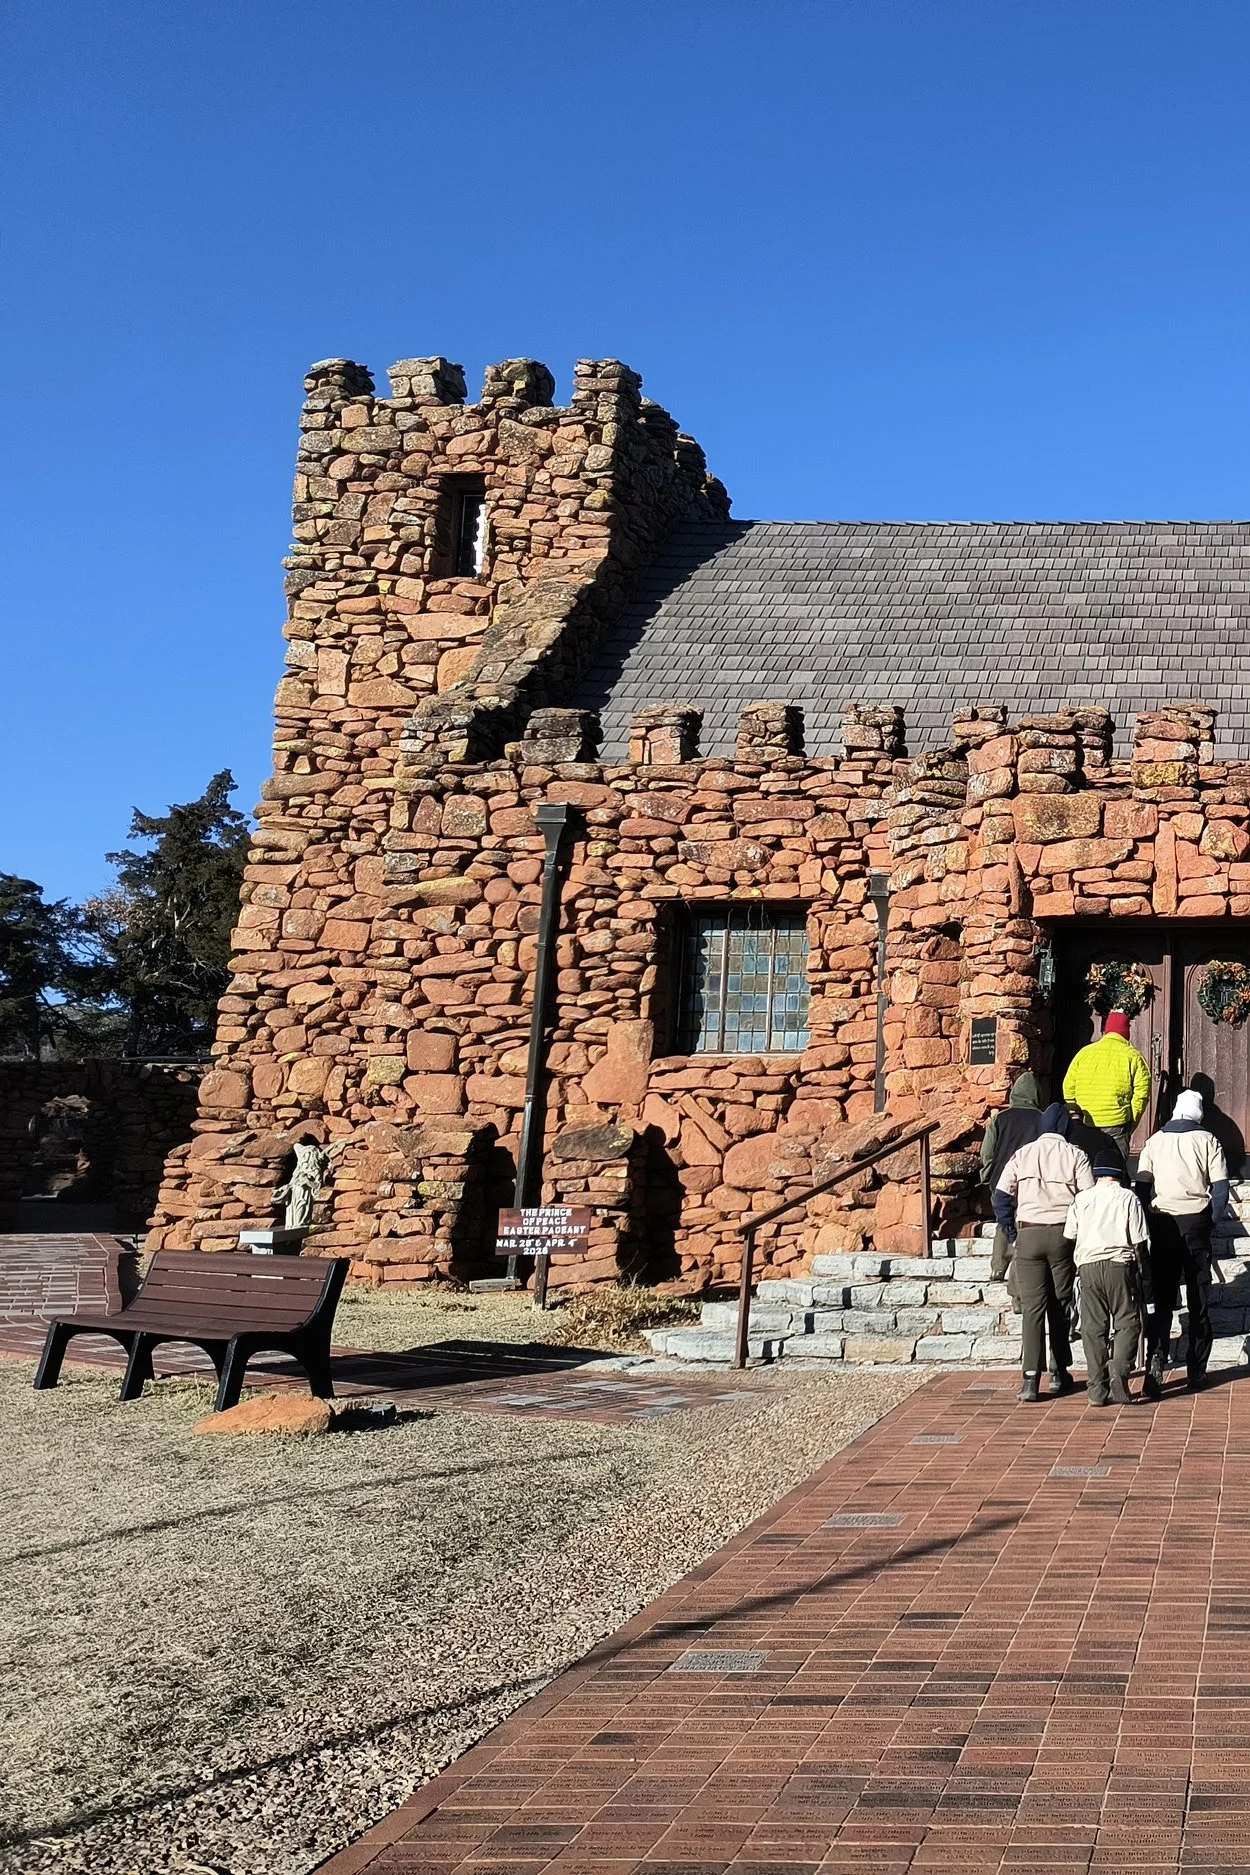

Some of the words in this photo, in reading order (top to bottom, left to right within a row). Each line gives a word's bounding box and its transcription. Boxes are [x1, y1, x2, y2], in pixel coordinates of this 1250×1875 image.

[520, 1208, 538, 1217] THE
[539, 1208, 573, 1217] PRINCE
[522, 1217, 535, 1226] OF
[536, 1216, 568, 1226] PEACE
[503, 1226, 540, 1236] EASTER
[542, 1225, 587, 1235] PAGEANT
[522, 1247, 549, 1256] 2026
